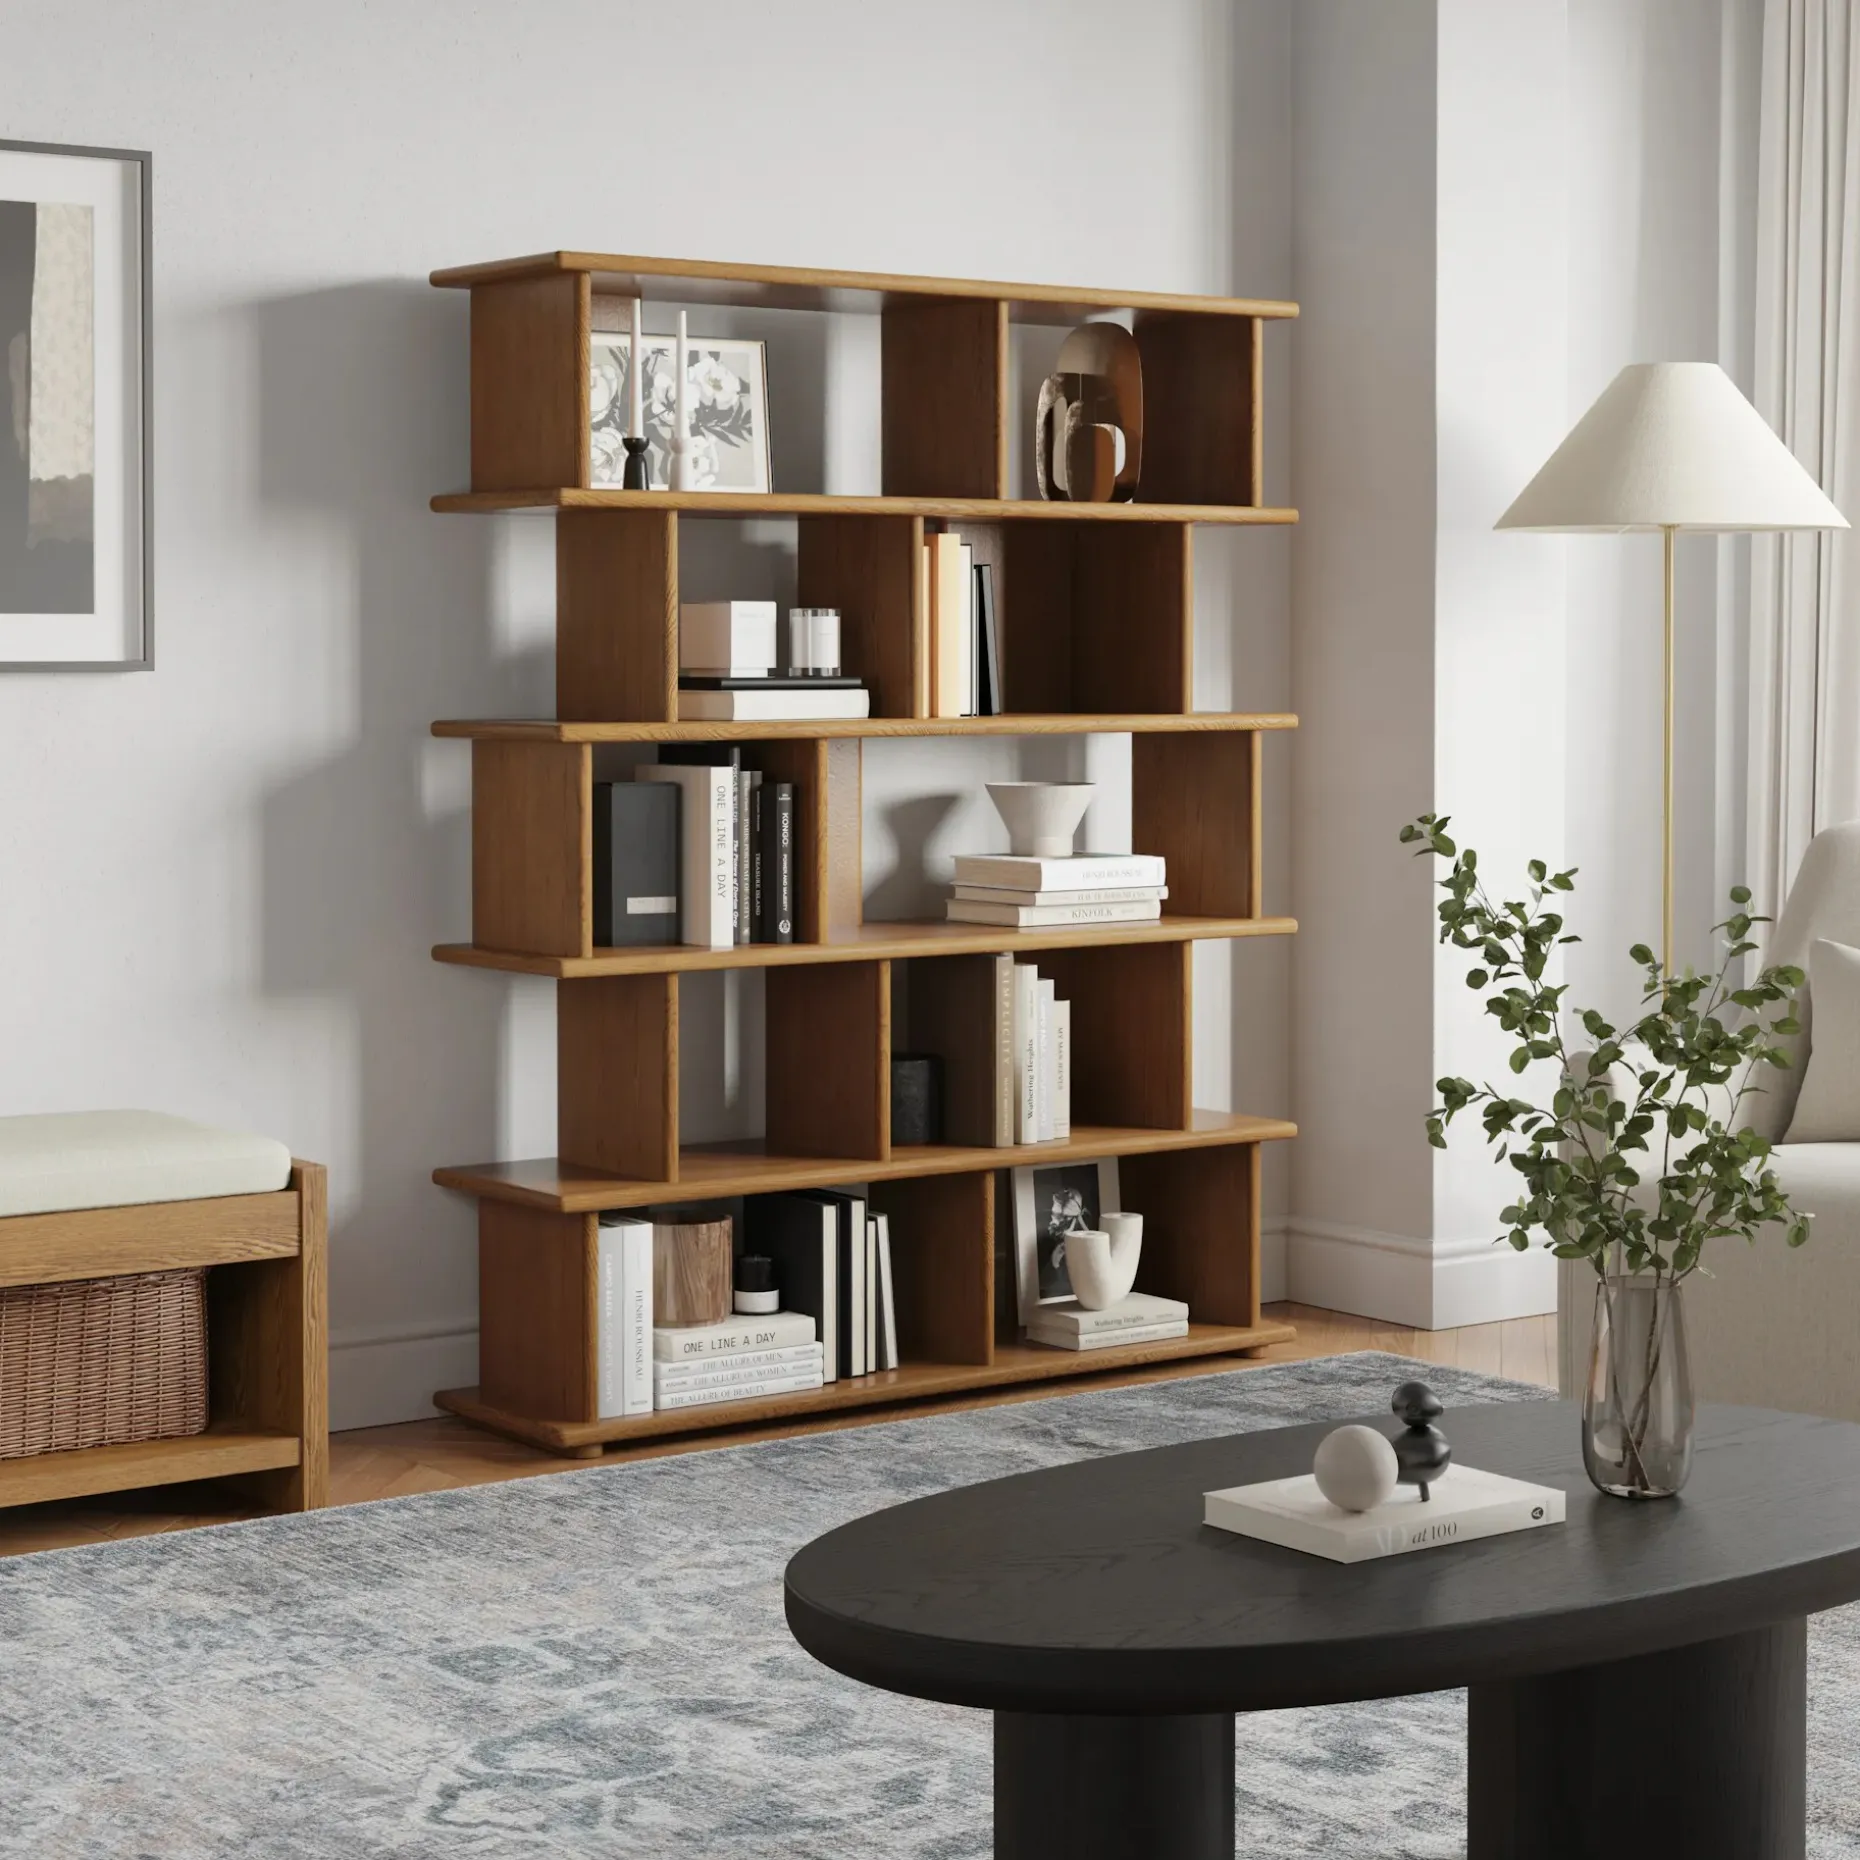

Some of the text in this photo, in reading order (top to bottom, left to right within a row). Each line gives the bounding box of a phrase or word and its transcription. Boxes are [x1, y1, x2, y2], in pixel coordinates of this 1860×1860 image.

[717, 785, 726, 898] ONE LINE A DAY
[1071, 908, 1113, 918] KINFOLK
[1002, 969, 1011, 1064] SIMPLICITY
[1027, 1039, 1035, 1073] Heights
[635, 1290, 643, 1381] HENRI ROUSSEAU
[683, 1332, 776, 1354] ONE LINE A DAY
[702, 1361, 716, 1371] THE
[765, 1352, 783, 1361] MEN
[693, 1377, 707, 1386] THE
[711, 1372, 740, 1383] ALLURE
[756, 1365, 787, 1377] WOMEN
[720, 1390, 731, 1398] OF
[733, 1385, 765, 1397] BEAUTY
[1412, 1527, 1427, 1545] at
[1431, 1521, 1457, 1540] 100
